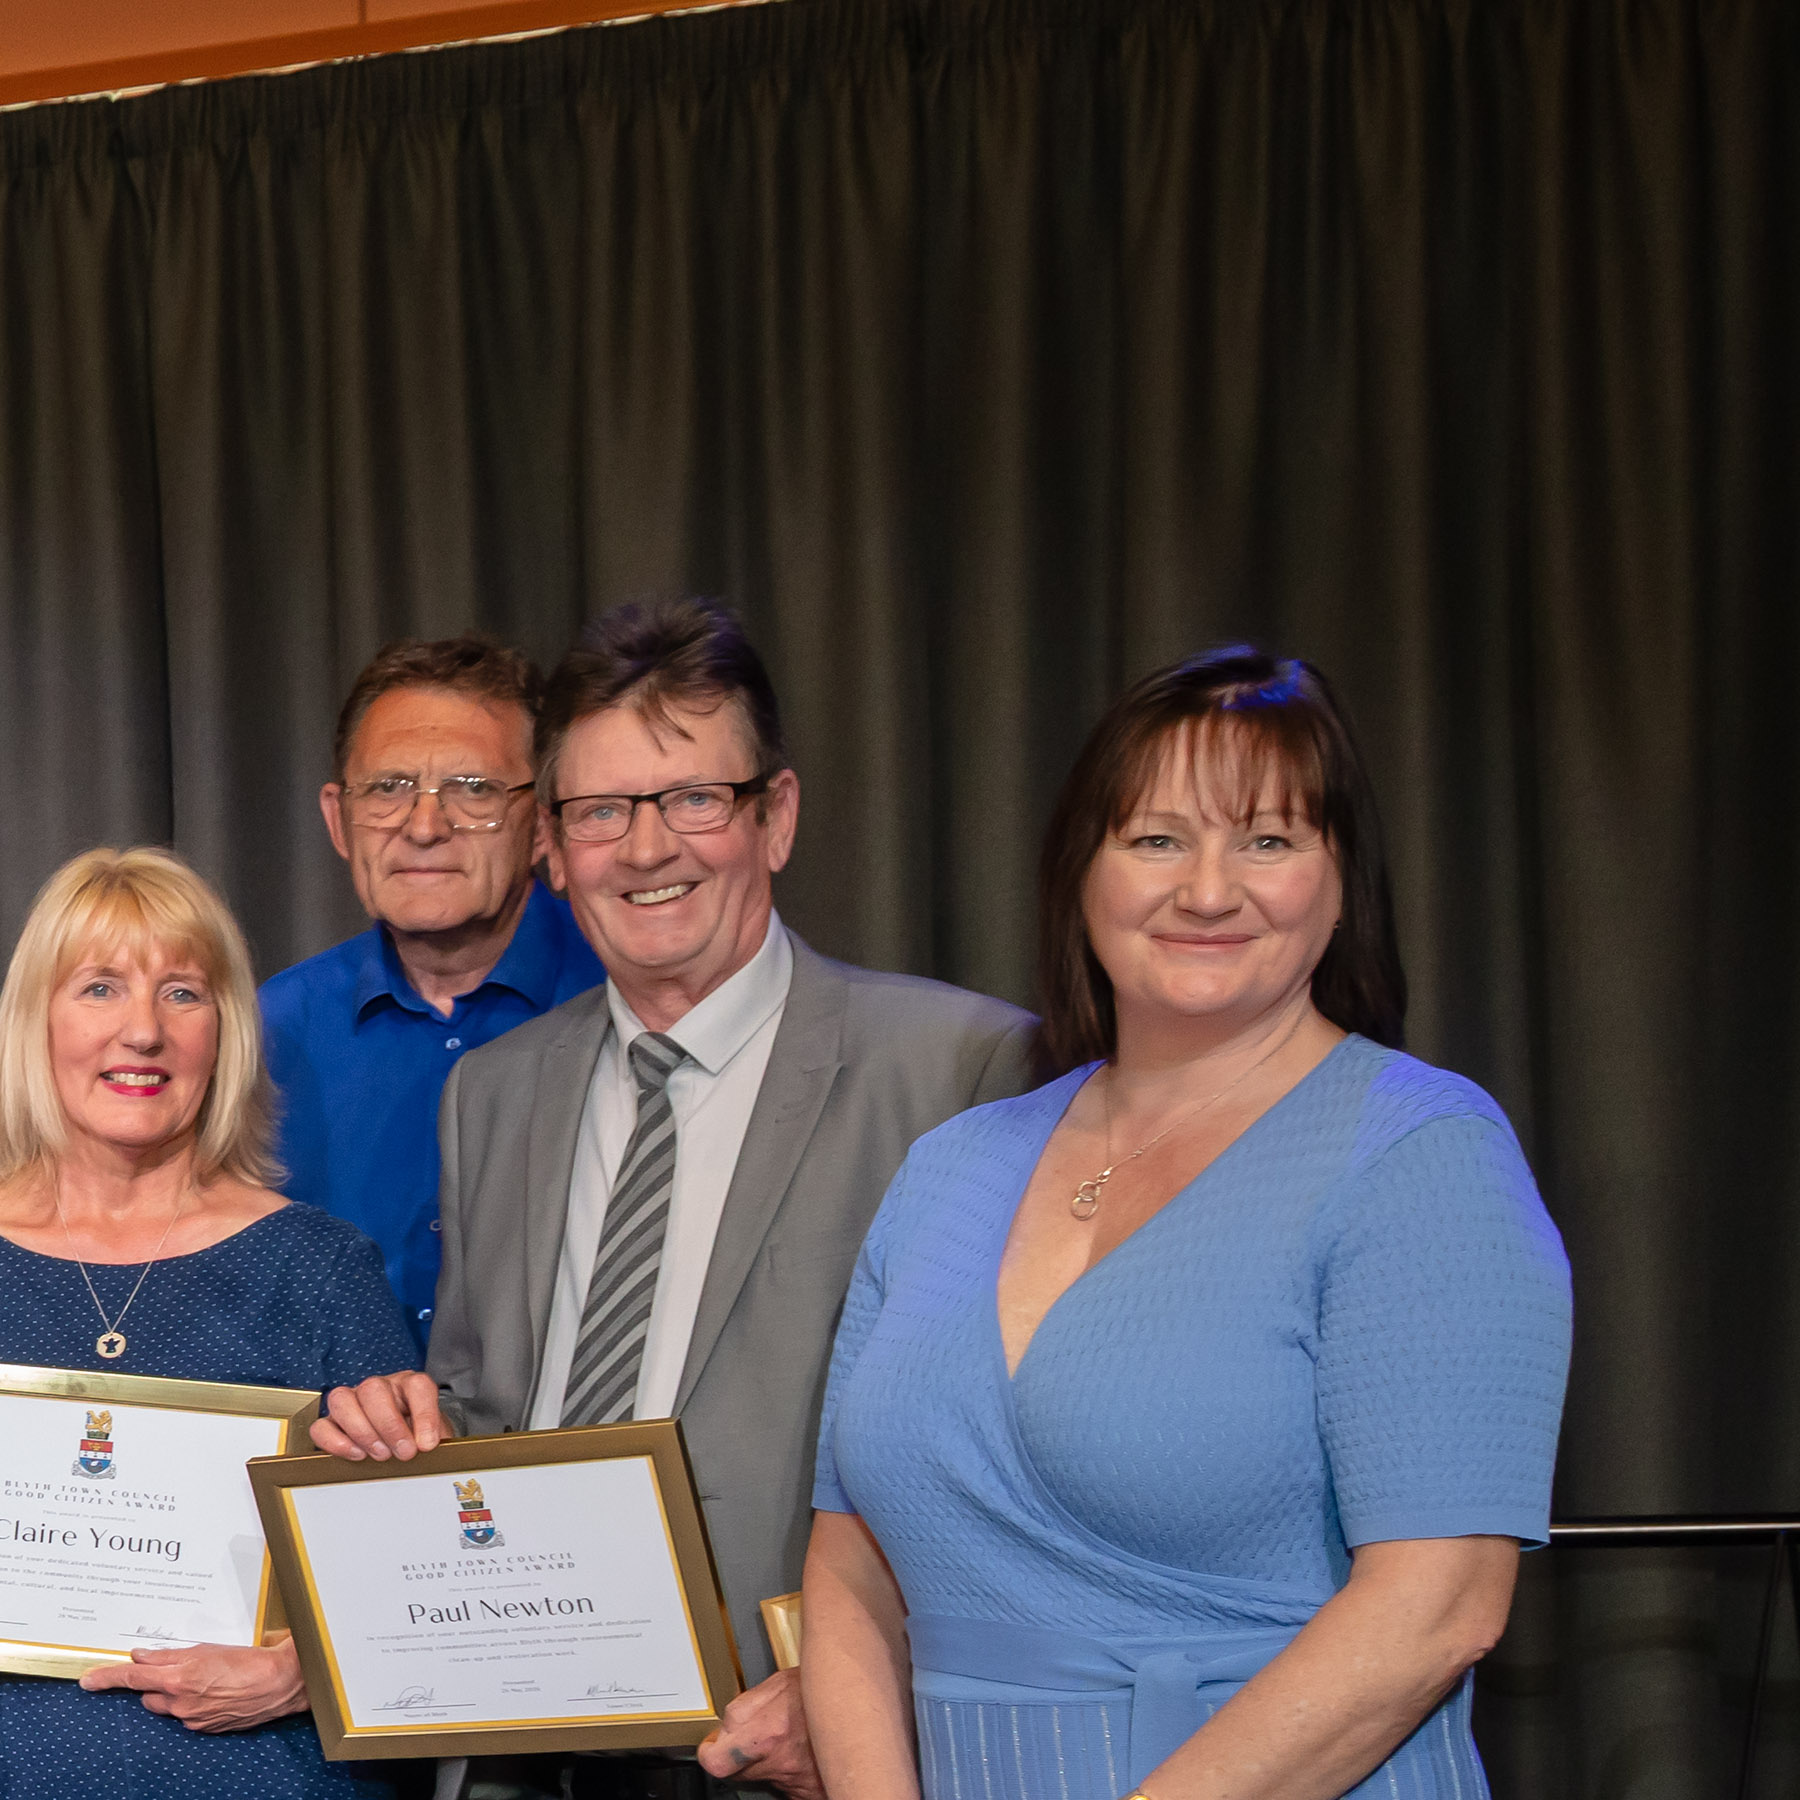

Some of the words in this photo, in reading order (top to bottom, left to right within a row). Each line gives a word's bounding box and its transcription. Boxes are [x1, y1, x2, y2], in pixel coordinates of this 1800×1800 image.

[4, 1490, 45, 1499] GOOD
[54, 1495, 114, 1505] CITIZEN
[126, 1501, 176, 1511] AWARD
[5, 1480, 51, 1491] BLYTH
[62, 1485, 101, 1495] TOWN
[111, 1490, 175, 1502] COUNCIL
[90, 1528, 181, 1562] Young
[402, 1562, 447, 1572] BLYTH
[457, 1558, 498, 1567] TOWN
[507, 1552, 572, 1564] COUNCIL
[405, 1572, 445, 1581] GOOD
[454, 1567, 514, 1577] CITIZEN
[524, 1562, 575, 1572] AWARD
[408, 1600, 471, 1624] Paul
[479, 1597, 594, 1619] Newton
